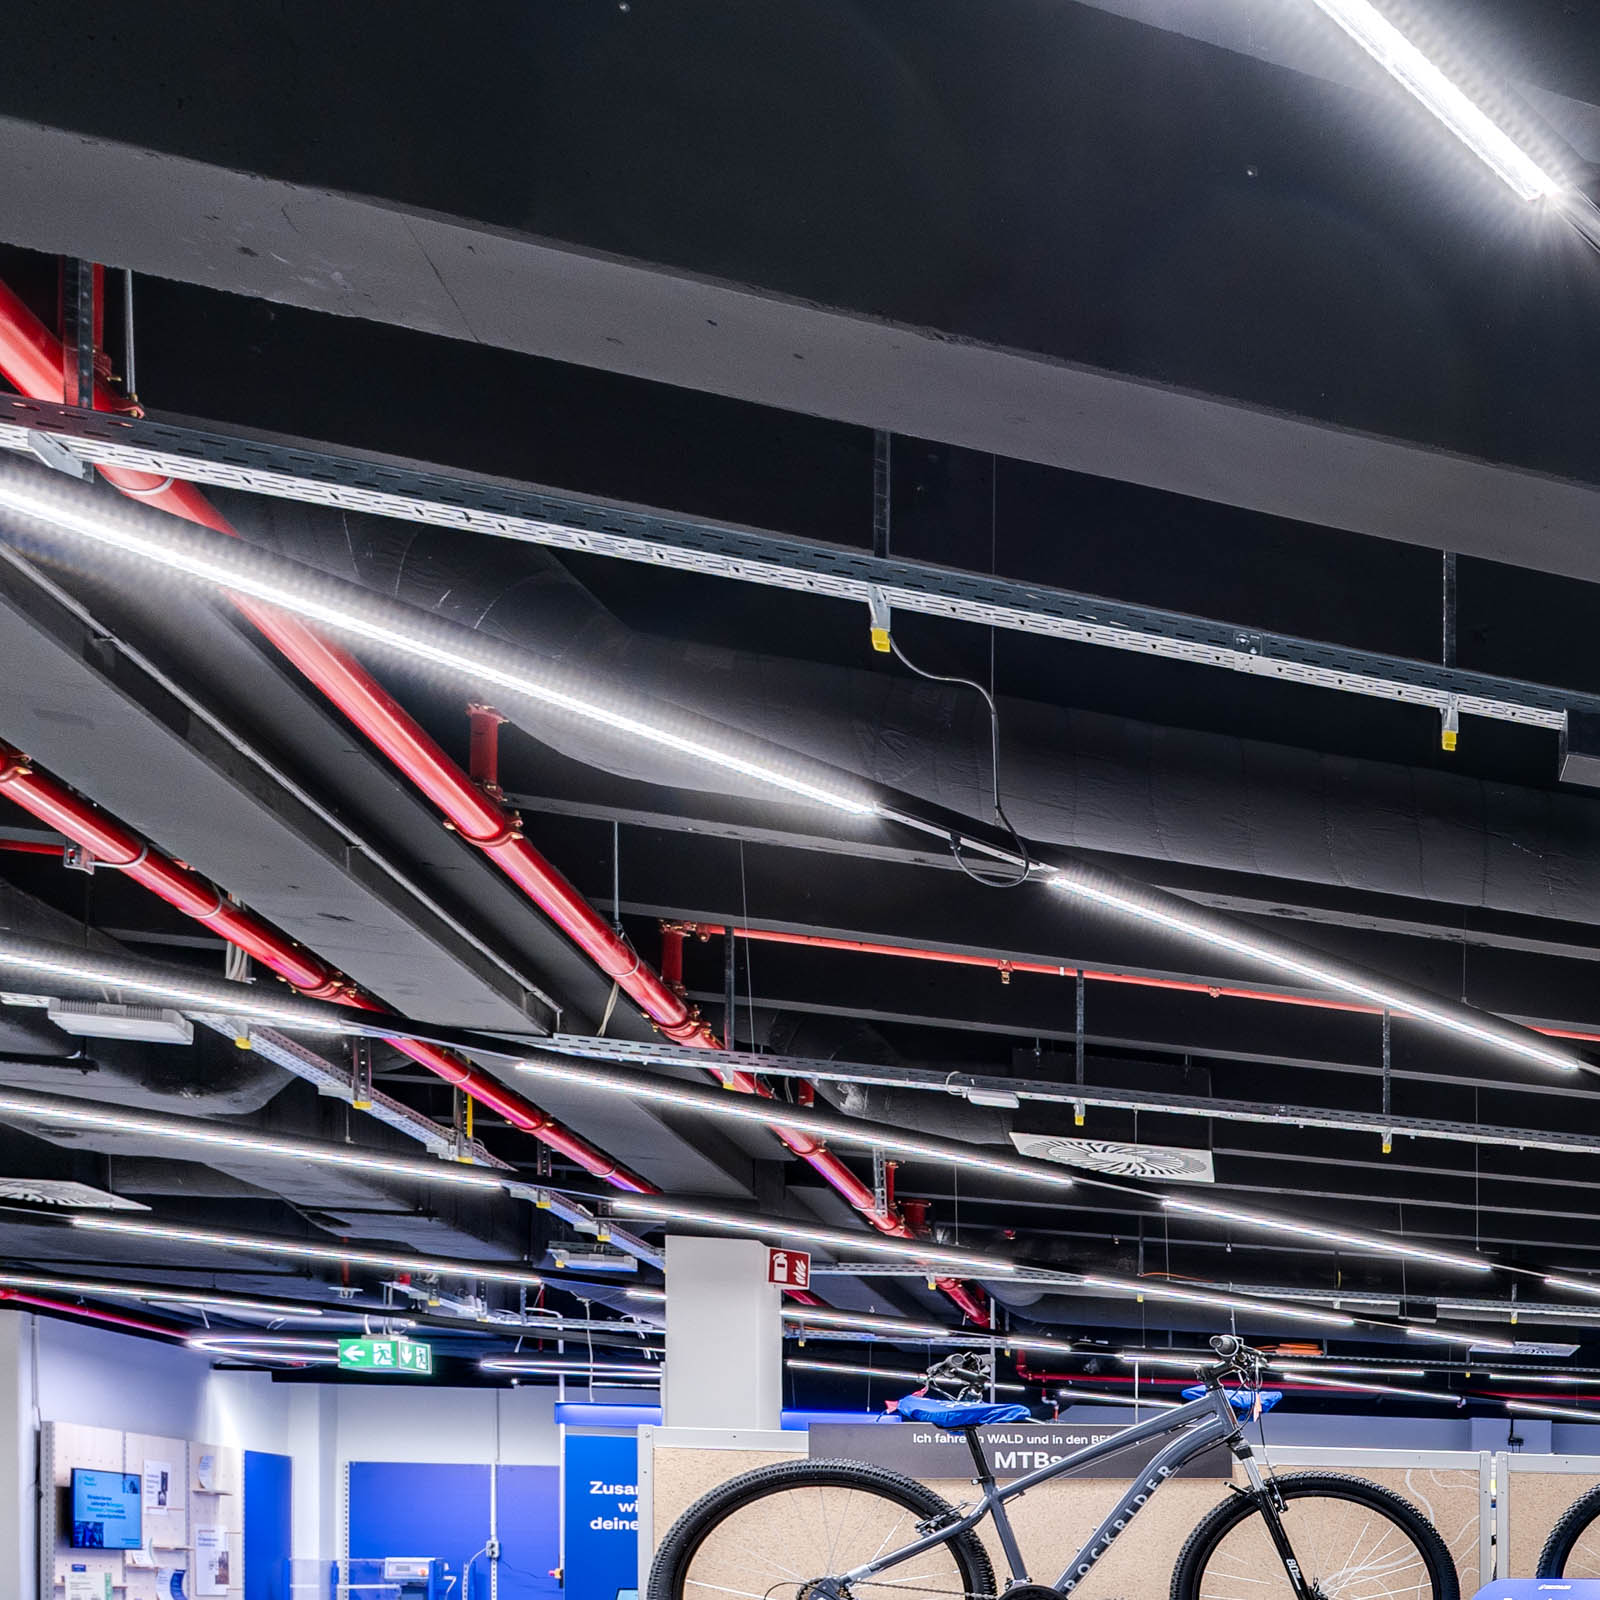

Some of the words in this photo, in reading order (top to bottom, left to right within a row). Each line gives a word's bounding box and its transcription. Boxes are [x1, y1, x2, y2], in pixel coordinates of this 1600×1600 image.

[913, 1433, 931, 1444] Ich
[935, 1433, 967, 1444] fahre
[988, 1434, 1023, 1444] WALD
[1027, 1434, 1048, 1444] und
[1053, 1434, 1063, 1444] in
[1066, 1434, 1088, 1444] den
[589, 1481, 639, 1495] Zusa
[1064, 1465, 1172, 1591] ROCKRIDER
